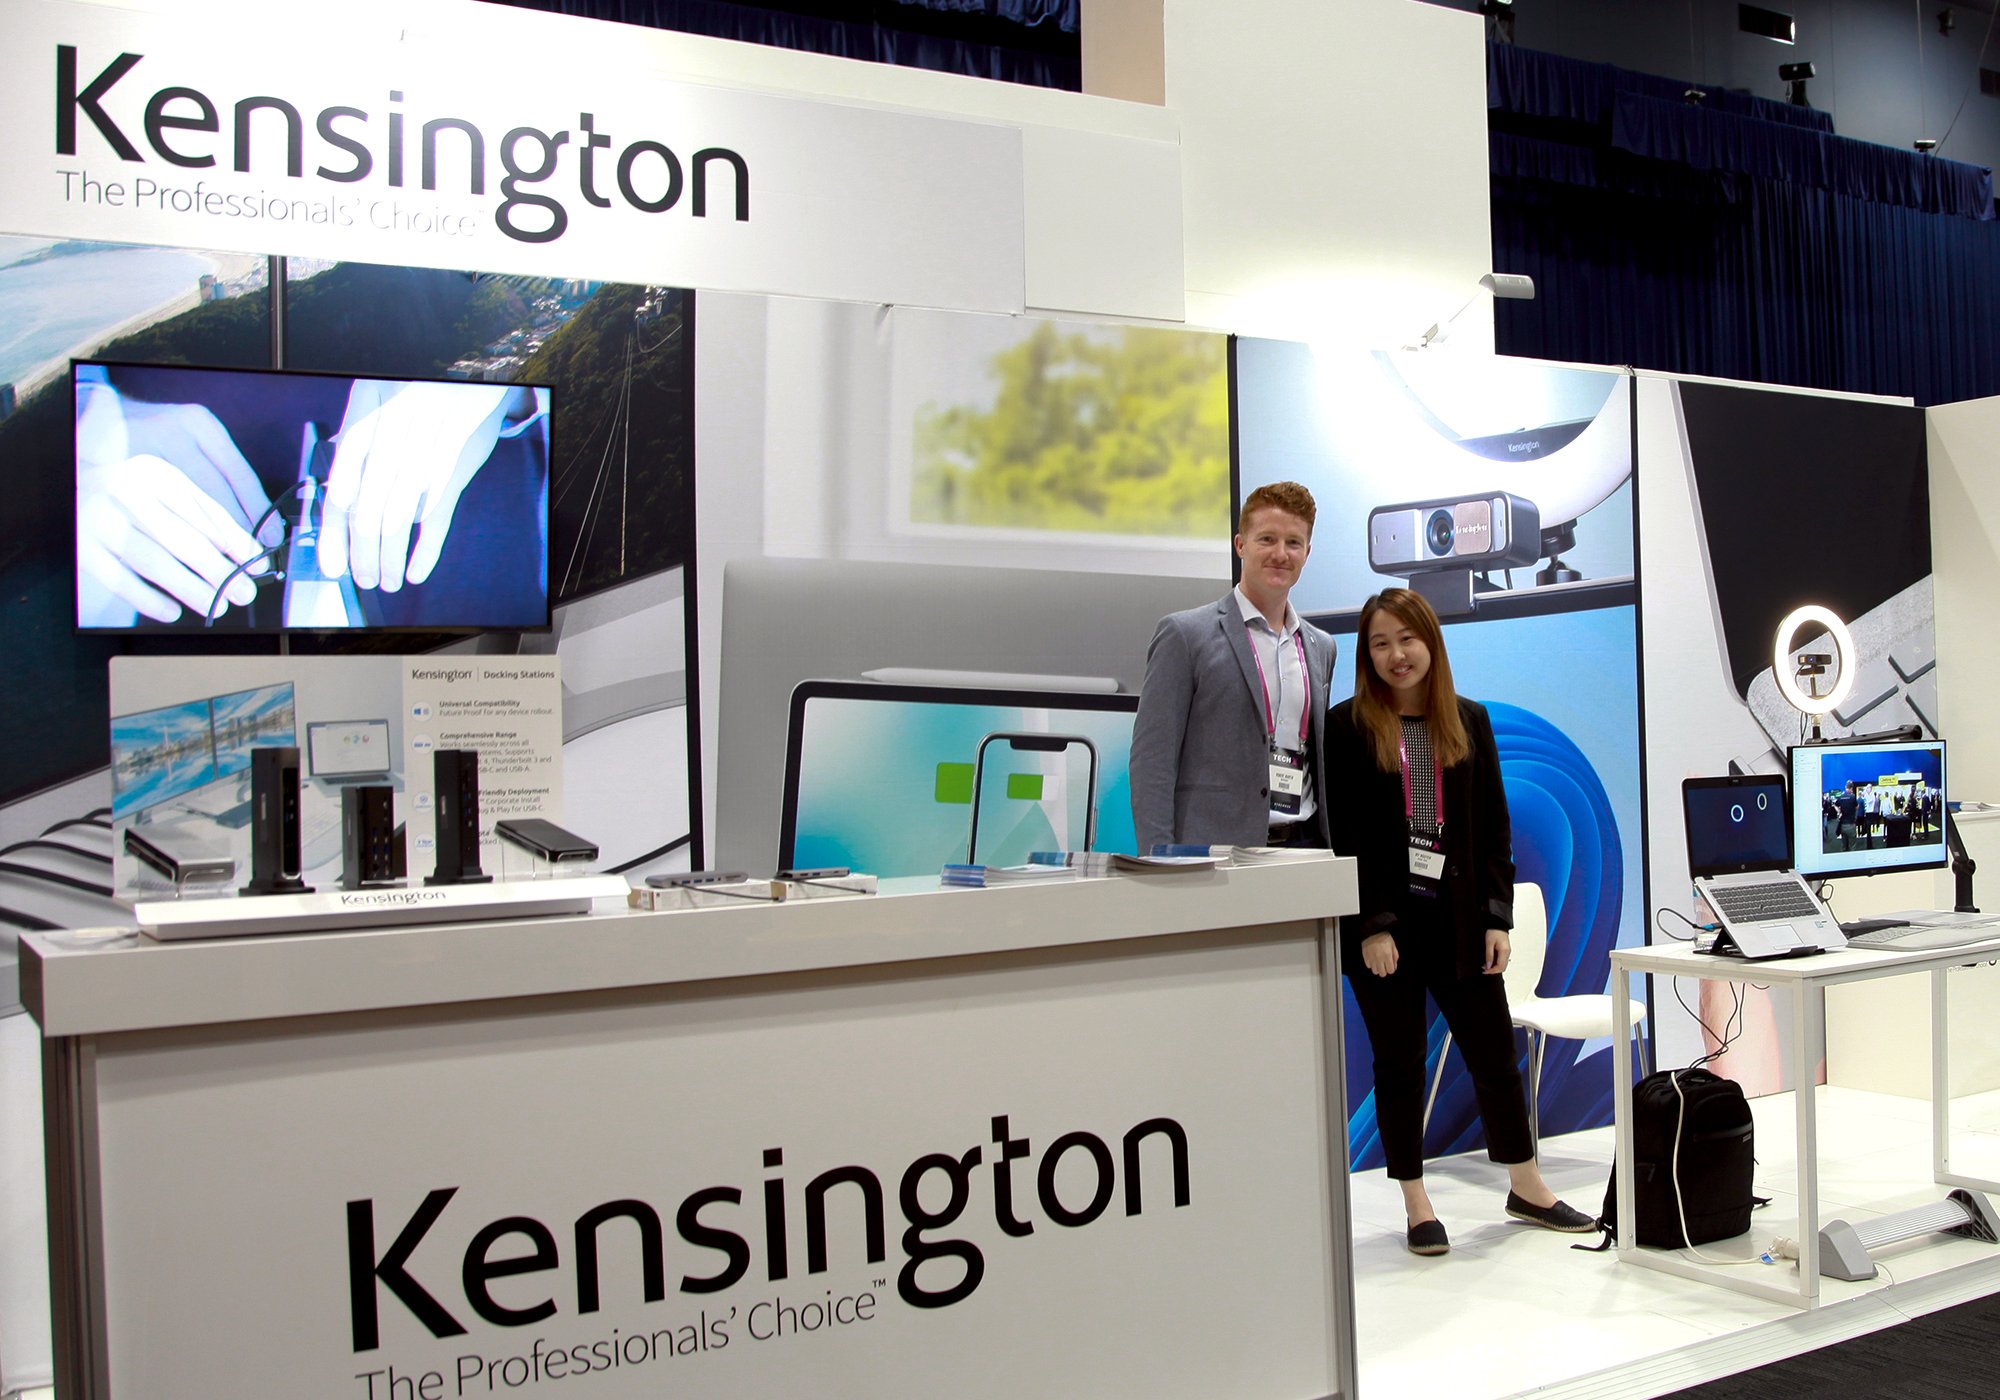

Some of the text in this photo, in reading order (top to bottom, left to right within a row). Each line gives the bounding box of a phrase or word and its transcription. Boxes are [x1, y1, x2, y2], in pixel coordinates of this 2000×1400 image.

[56, 44, 749, 243] Kensington
[56, 170, 126, 207] The
[412, 669, 555, 683] Kensington Docking Stations
[439, 700, 521, 708] Universal Compatibility
[495, 732, 517, 740] Range
[1273, 753, 1292, 764] TECH
[508, 787, 550, 797] Deployment
[1410, 836, 1433, 847] TECH
[341, 890, 446, 905] Kensington
[346, 1114, 1190, 1353] Kensington
[354, 1365, 444, 1400] The
